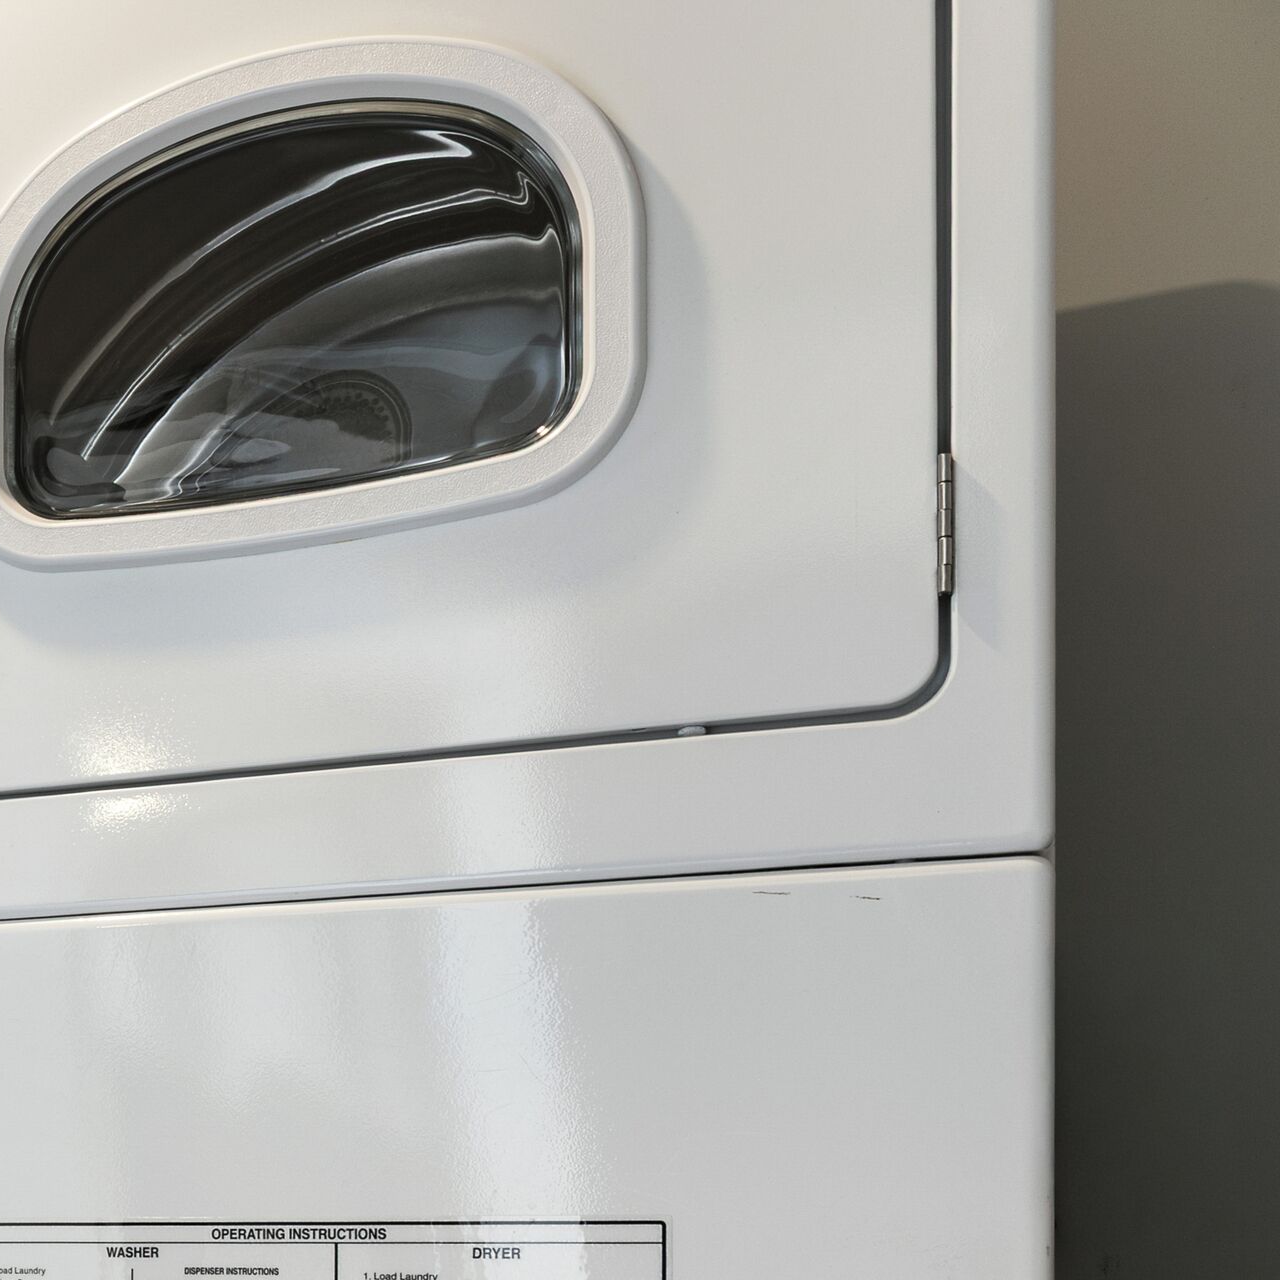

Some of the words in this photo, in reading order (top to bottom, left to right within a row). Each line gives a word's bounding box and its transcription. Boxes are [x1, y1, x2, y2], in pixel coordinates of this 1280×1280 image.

[211, 1228, 286, 1240] OPERATING
[289, 1227, 387, 1240] INSTRUCTIONS
[106, 1246, 159, 1259] WASHER
[472, 1248, 521, 1259] DRYER
[14, 1267, 46, 1276] Laundry
